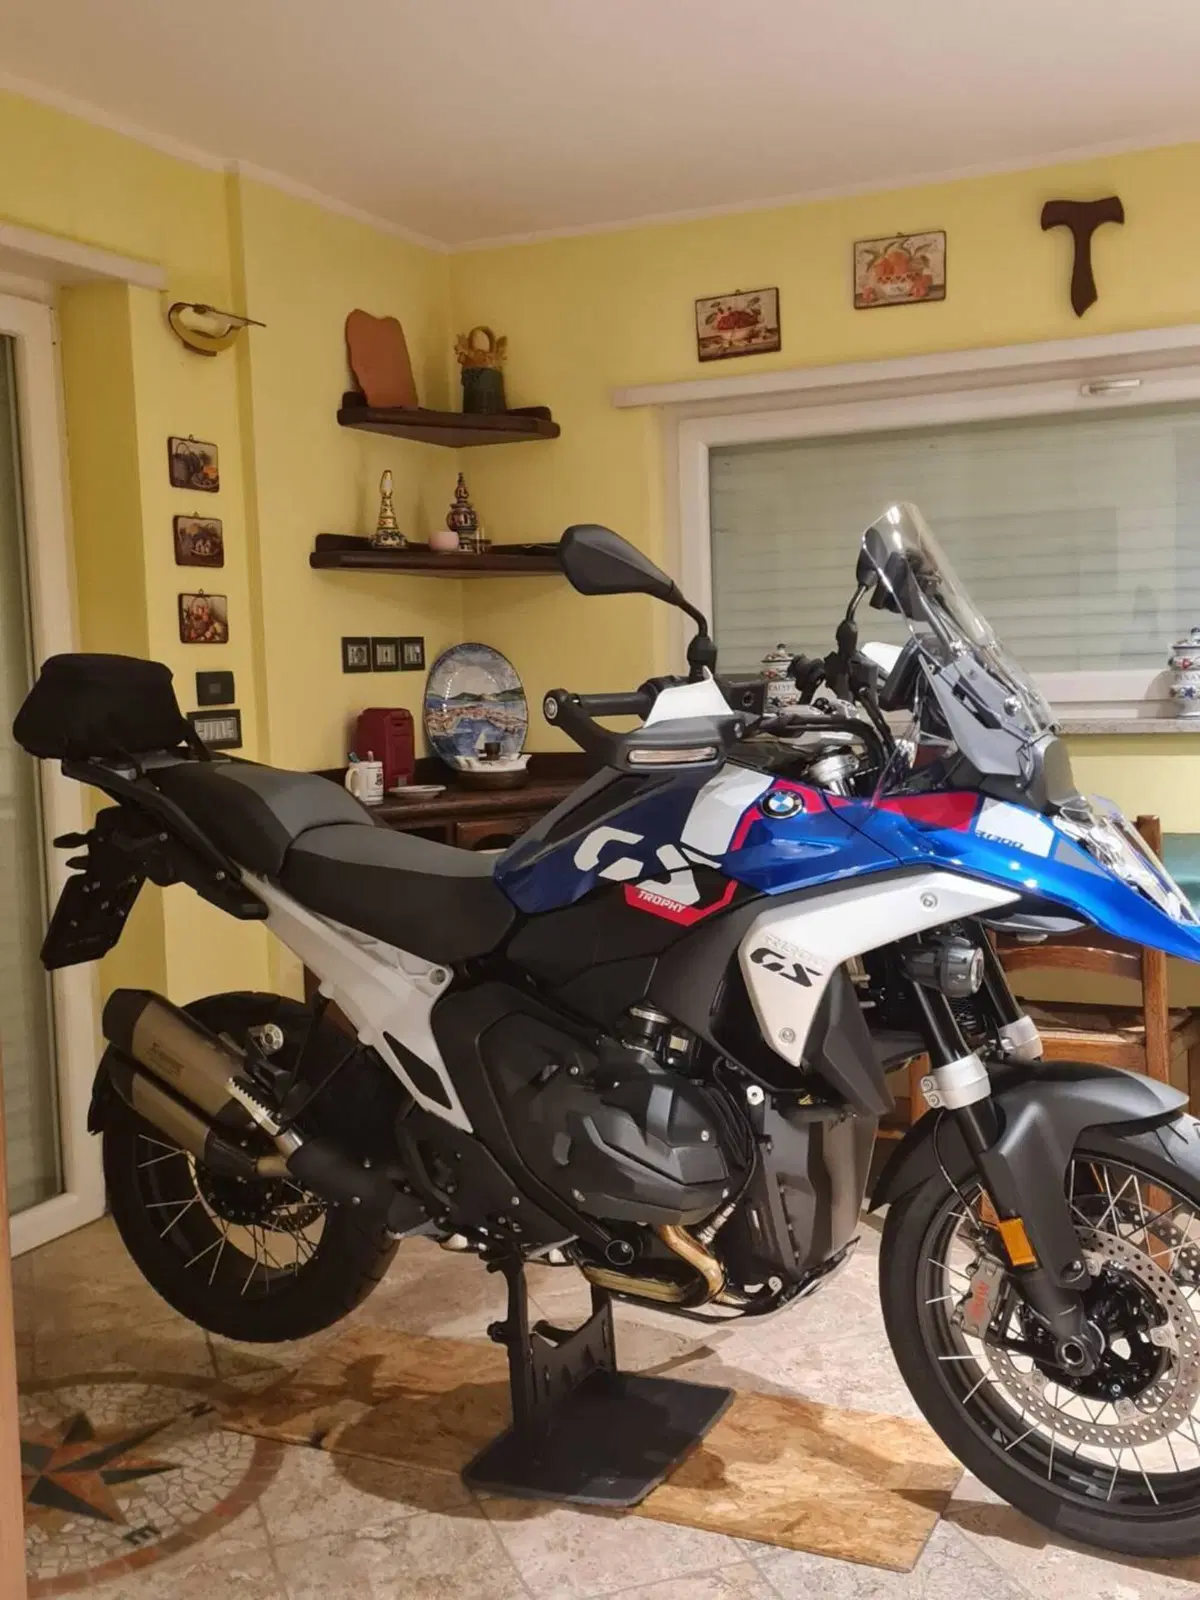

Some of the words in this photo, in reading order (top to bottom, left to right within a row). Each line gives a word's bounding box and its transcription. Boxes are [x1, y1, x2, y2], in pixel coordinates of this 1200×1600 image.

[574, 826, 722, 905] GS
[638, 889, 687, 913] TROPHY
[750, 947, 823, 987] GS
